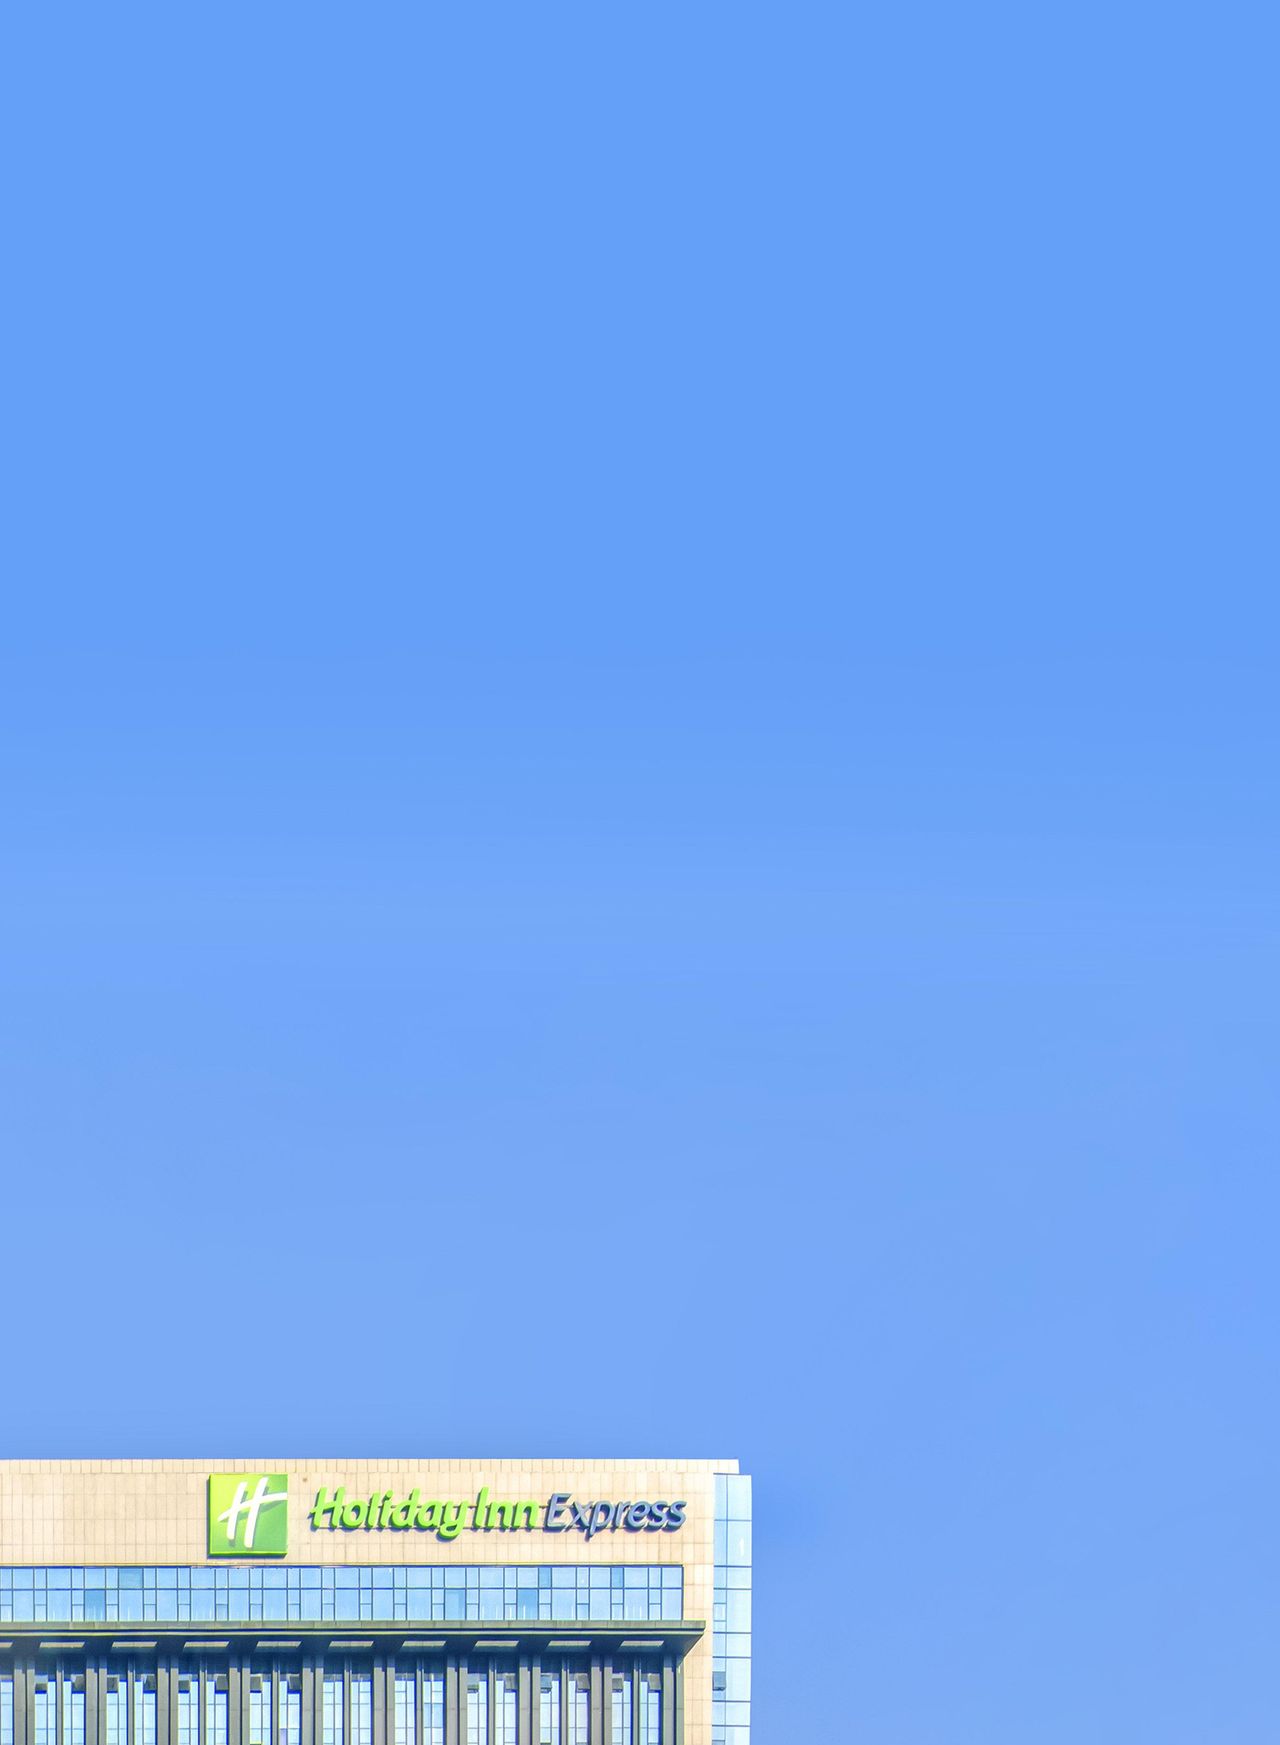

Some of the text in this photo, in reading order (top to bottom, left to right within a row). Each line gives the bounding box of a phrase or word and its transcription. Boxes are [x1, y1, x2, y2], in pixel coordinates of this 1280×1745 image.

[307, 1486, 688, 1540] Holiday Inn Express
